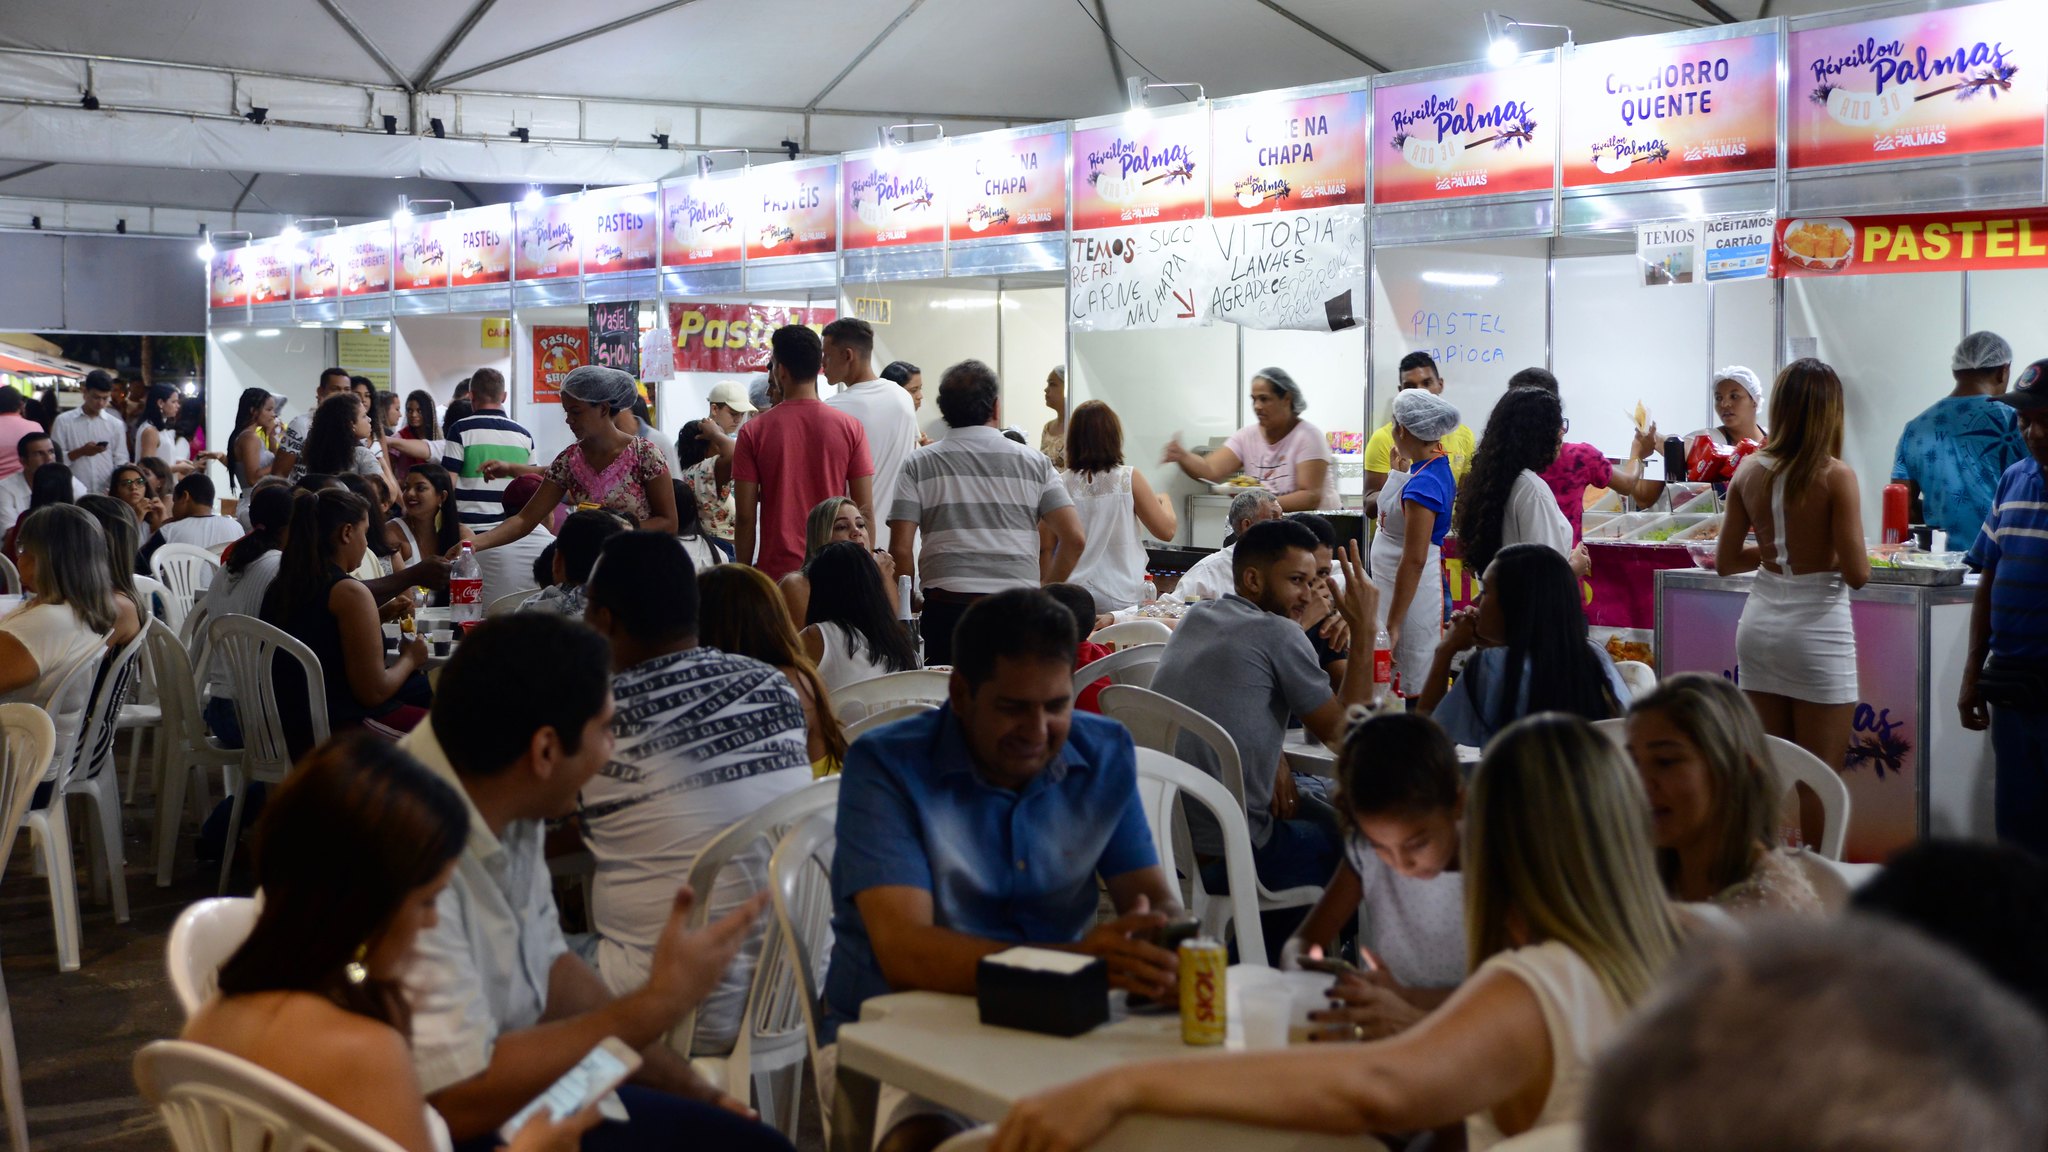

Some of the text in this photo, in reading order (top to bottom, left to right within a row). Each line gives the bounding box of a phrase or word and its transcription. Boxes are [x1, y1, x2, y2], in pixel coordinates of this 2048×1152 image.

[1810, 37, 1904, 83] Réveillon
[1870, 42, 2013, 95] Palmas
[1391, 94, 1458, 133] Réveillon
[1621, 88, 1712, 127] QUENTE
[1304, 113, 1329, 137] NA
[1433, 100, 1534, 143] Palmas
[1615, 139, 1668, 160] Palmas
[1702, 143, 1746, 158] PALMAS
[1895, 132, 1946, 147] PALMAS
[1020, 151, 1038, 170] NA
[1087, 137, 1138, 170] Réveillon
[1119, 144, 1193, 180] Palmas
[1258, 142, 1314, 167] CHAPA
[851, 168, 890, 195] Réveillon
[876, 176, 930, 206] Palmas
[985, 176, 1027, 196] CHAPA
[1251, 177, 1291, 197] Palmas
[1313, 184, 1346, 196] PALMAS
[1451, 174, 1487, 187] PALMAS
[1132, 207, 1160, 218] PALMAS
[1072, 237, 1135, 263] TEMOS
[1149, 225, 1194, 253] SUCO
[1643, 228, 1695, 245] TEMOS
[1716, 234, 1763, 249] CARTÃO
[1863, 218, 2047, 262] PASTEL
[1072, 279, 1142, 319] CARNE
[1212, 275, 1287, 317] AGRADECE
[1411, 310, 1505, 340] PASTEL
[540, 333, 582, 351] Pastel
[598, 340, 632, 368] SHOW
[545, 373, 566, 383] SHO
